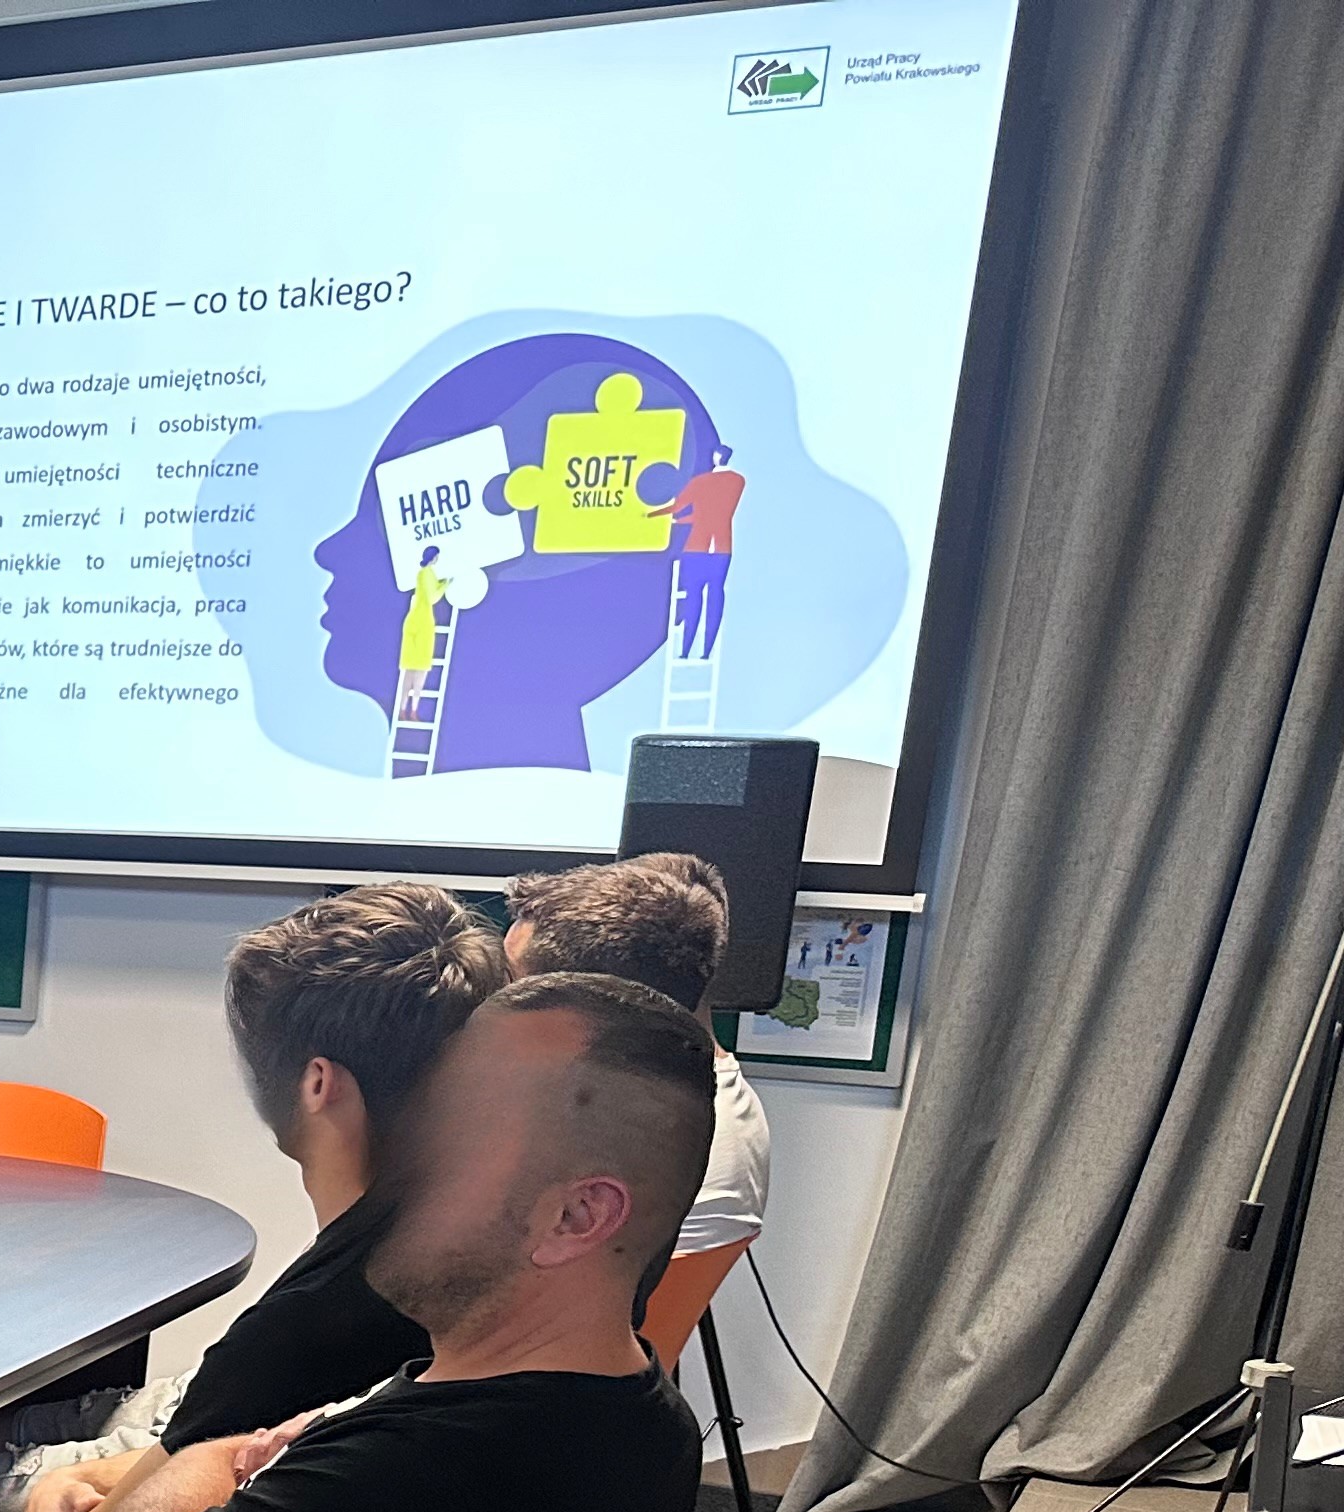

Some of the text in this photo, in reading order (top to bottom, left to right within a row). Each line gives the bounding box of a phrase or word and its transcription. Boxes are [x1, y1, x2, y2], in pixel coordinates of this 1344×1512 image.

[844, 62, 981, 85] Powiatu Krakowskiego
[847, 53, 921, 69] Urząd Pracy
[16, 298, 23, 327] I
[30, 289, 158, 325] TWARDE
[193, 291, 228, 316] co
[236, 285, 268, 313] to
[277, 270, 413, 314] takiego?
[16, 376, 55, 396] dwa
[62, 372, 131, 396] rodzaje
[138, 364, 267, 393] umiejętności,
[130, 415, 137, 436] i
[158, 412, 263, 436] osobistym.
[4, 462, 121, 487] umiejętności
[155, 458, 260, 480] techniczne
[564, 455, 638, 489] SOFT
[398, 479, 472, 526] HARD
[572, 490, 624, 509] SKILLS
[21, 507, 101, 531] zmierzyć
[119, 506, 125, 526] i
[143, 503, 256, 529] potwierdzić
[413, 513, 463, 542] SKILLS
[85, 554, 105, 571] to
[130, 548, 252, 573] umiejętności
[22, 596, 51, 620] jak
[61, 595, 182, 619] komunikacja,
[194, 598, 247, 618] praca
[32, 639, 80, 658] które
[84, 643, 104, 662] są
[110, 638, 213, 661] trudniejsze
[218, 637, 244, 657] do
[59, 681, 87, 700] dla
[118, 682, 240, 706] efektywnego
